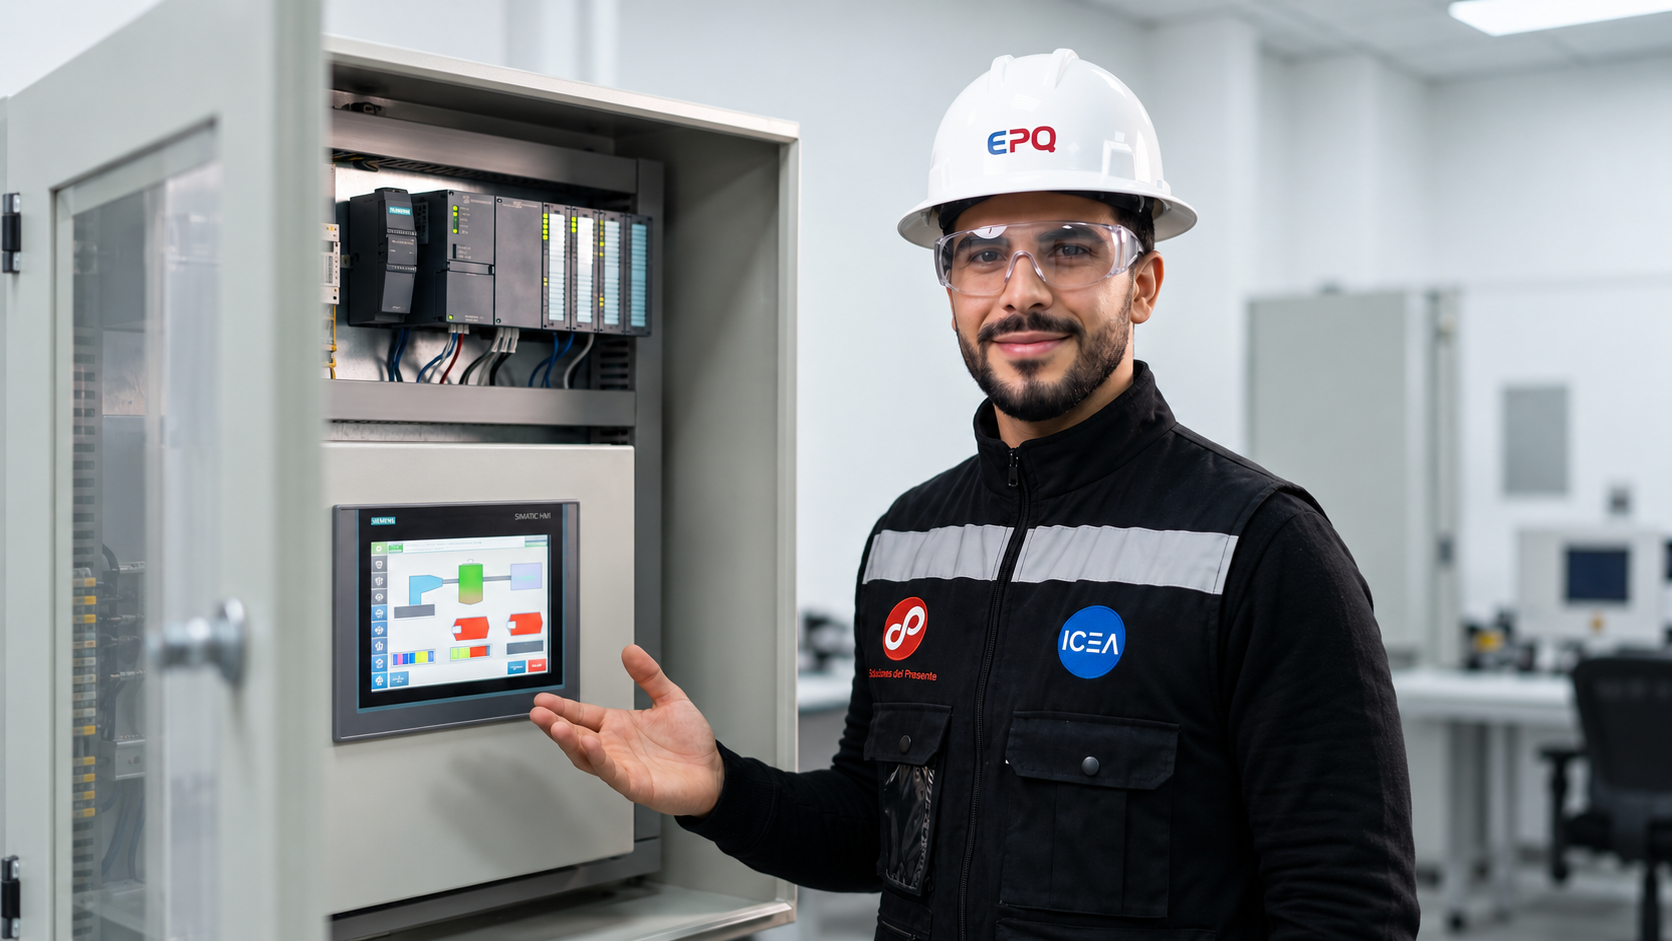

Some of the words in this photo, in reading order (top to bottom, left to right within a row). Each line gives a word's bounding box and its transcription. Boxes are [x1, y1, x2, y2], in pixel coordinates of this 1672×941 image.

[987, 125, 1057, 156] EPQ
[1062, 630, 1119, 656] ICEA
[904, 669, 938, 682] Presente
